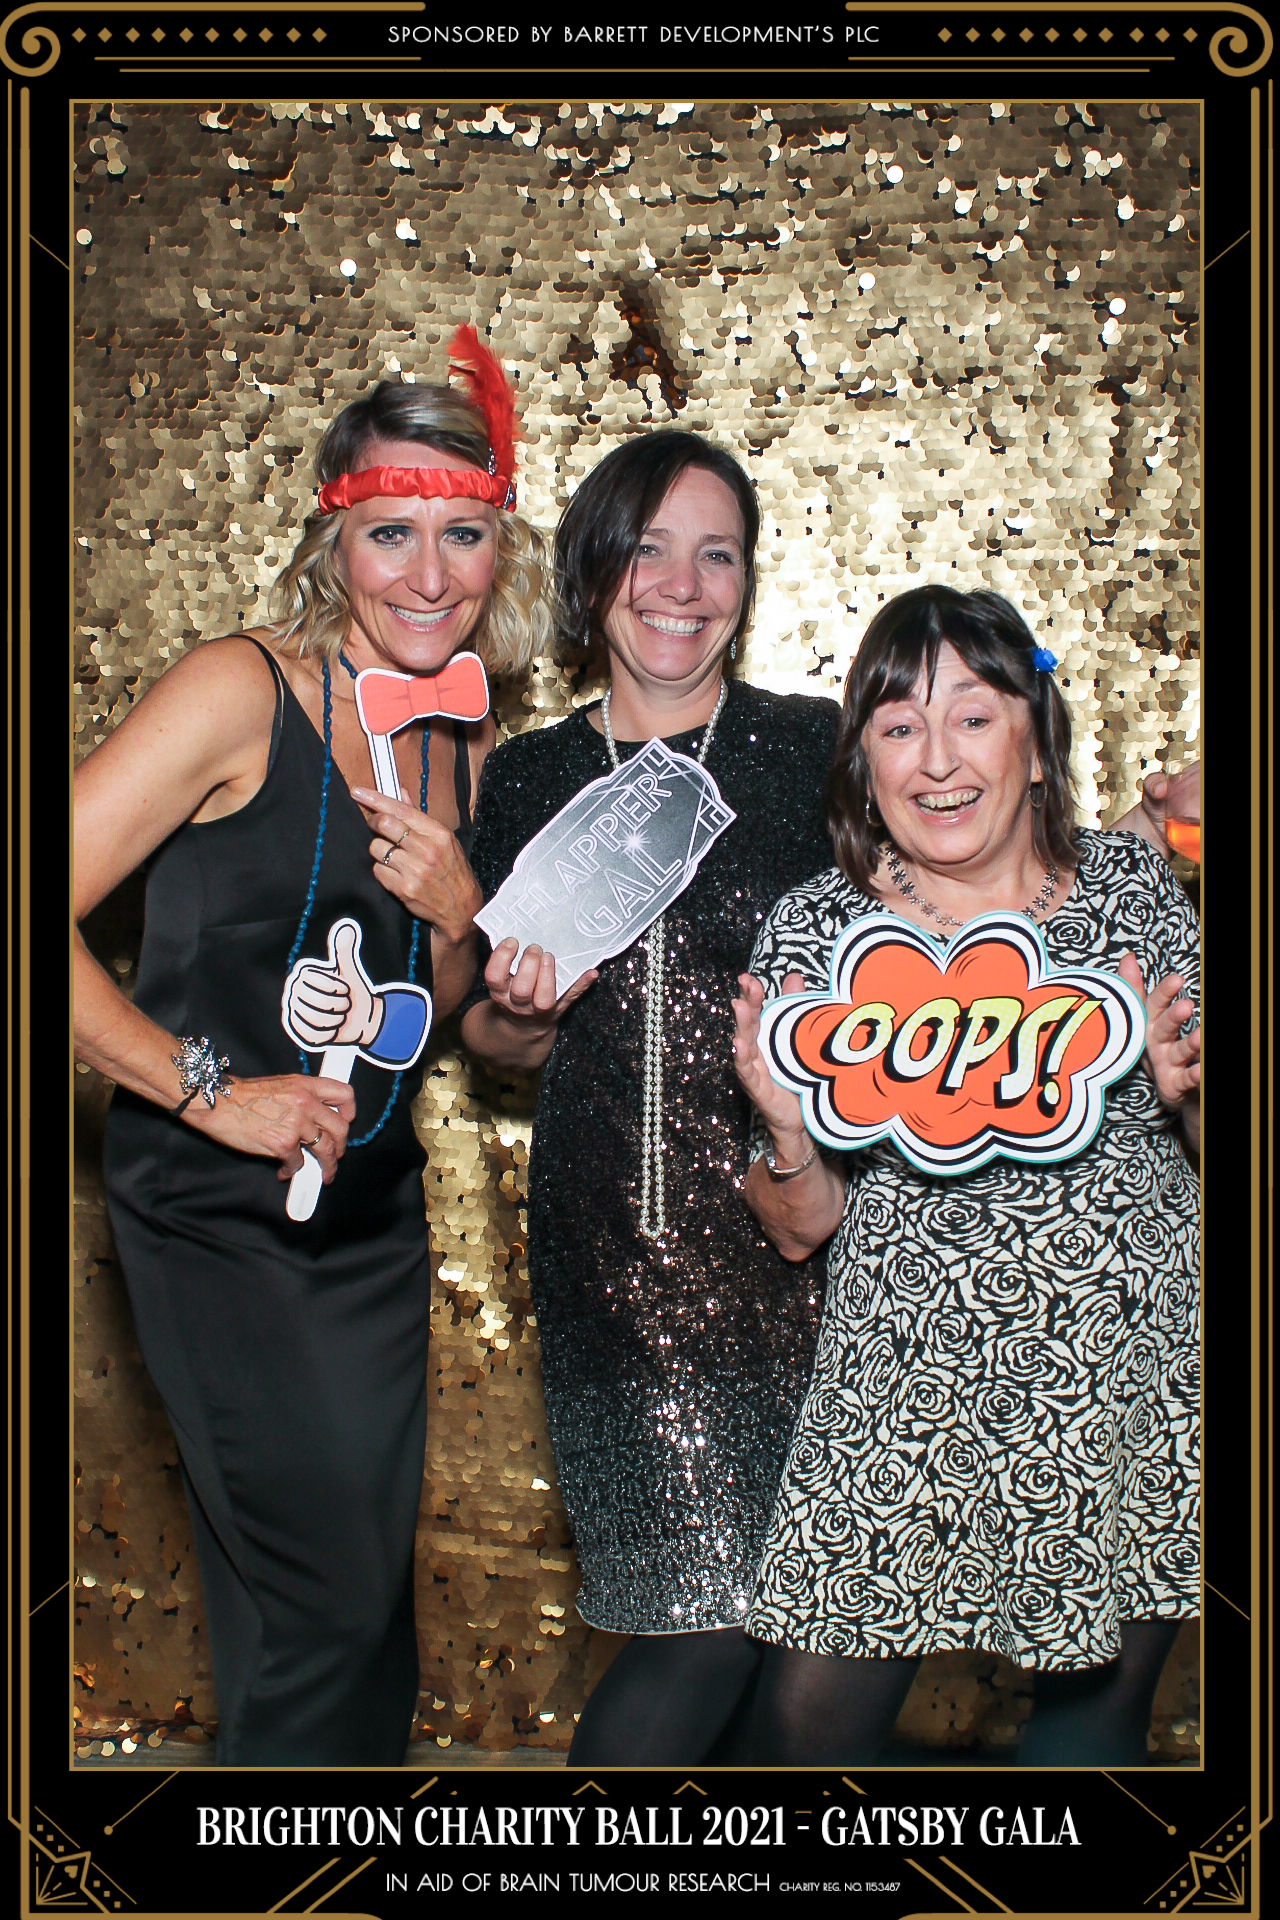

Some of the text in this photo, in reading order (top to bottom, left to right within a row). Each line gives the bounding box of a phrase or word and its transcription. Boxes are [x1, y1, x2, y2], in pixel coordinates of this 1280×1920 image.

[509, 772, 673, 932] FLAPPER
[573, 843, 683, 938] GAL
[821, 996, 1108, 1117] OOPS!
